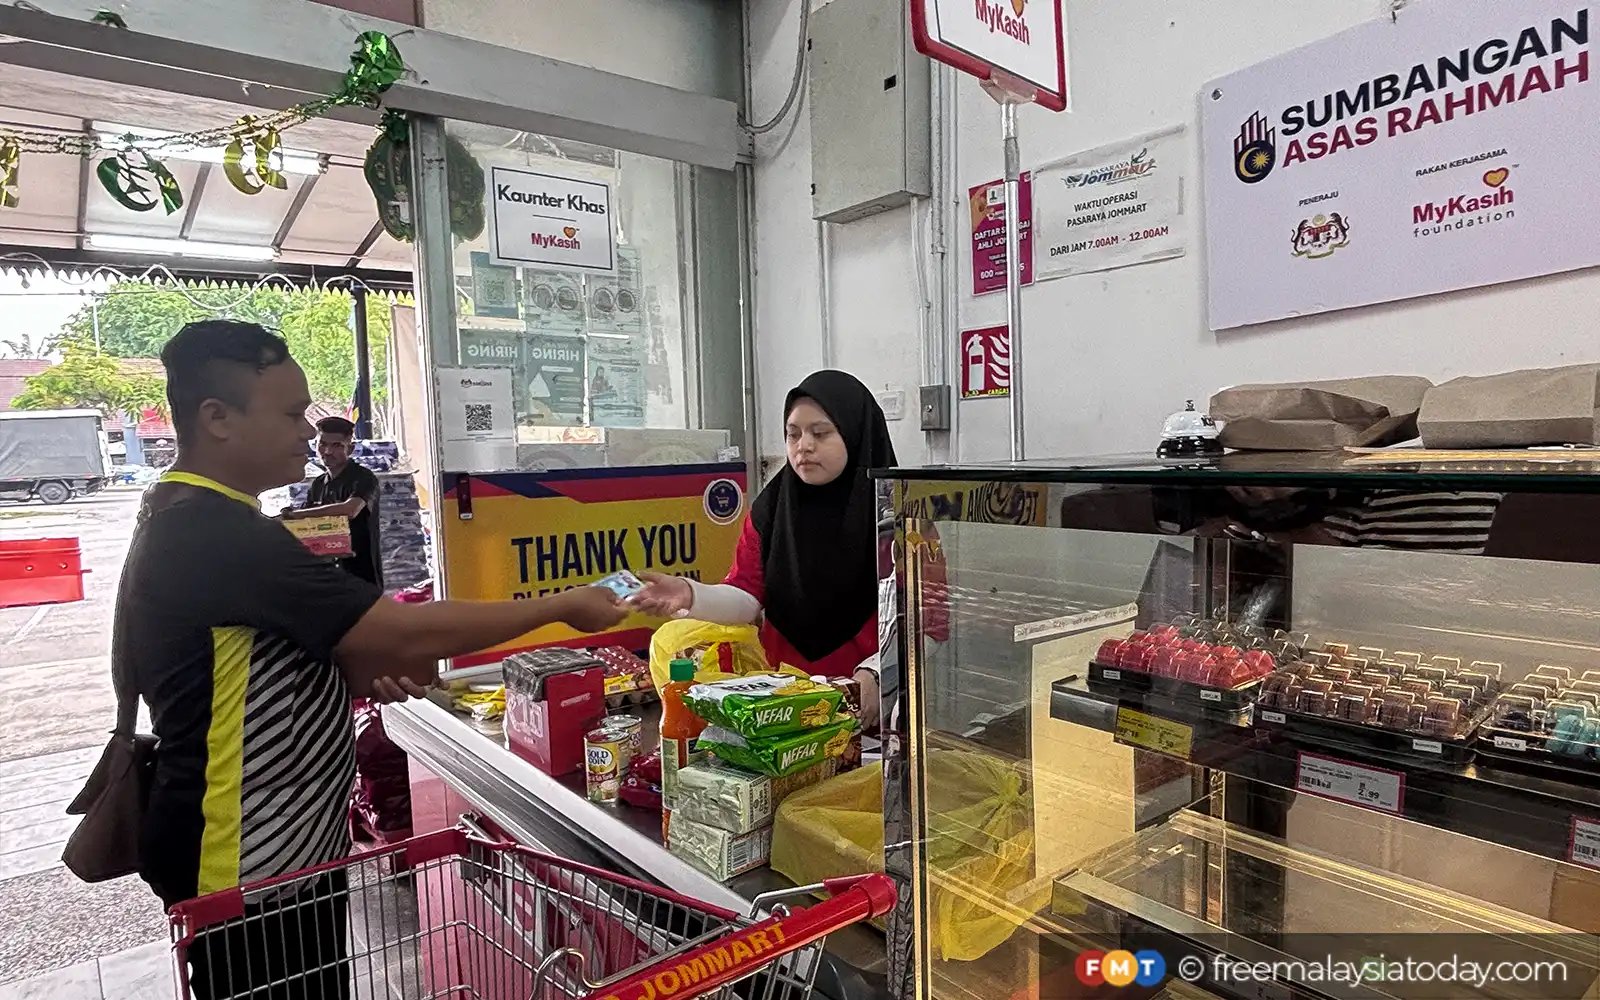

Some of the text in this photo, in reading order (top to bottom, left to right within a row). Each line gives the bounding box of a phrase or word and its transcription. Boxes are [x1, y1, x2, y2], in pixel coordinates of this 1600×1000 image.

[975, 0, 1030, 46] MyKasih
[1280, 9, 1589, 137] SUMBANGAN
[1282, 50, 1589, 168] ASAS RAHMAH
[1090, 161, 1130, 176] PASARAYA
[1415, 148, 1508, 177] RAKAN KERJASAMA
[497, 183, 606, 215] Kaunter Khas
[1073, 190, 1138, 213] WAKTU OPERASI
[1298, 190, 1339, 207] PENERAJU
[1412, 186, 1514, 224] MyKasih
[1066, 203, 1147, 228] PASARAYA JOMMART
[1413, 209, 1515, 238] foundation
[531, 232, 581, 250] MyKasih
[1050, 244, 1070, 257] DARI
[1070, 241, 1087, 253] JAM
[1088, 235, 1119, 249] 7.00AM
[1129, 226, 1169, 242] 12.00AM
[511, 522, 697, 584] THANK YOU
[1357, 788, 1380, 800] 2.99
[637, 922, 787, 1000] JOMMART
